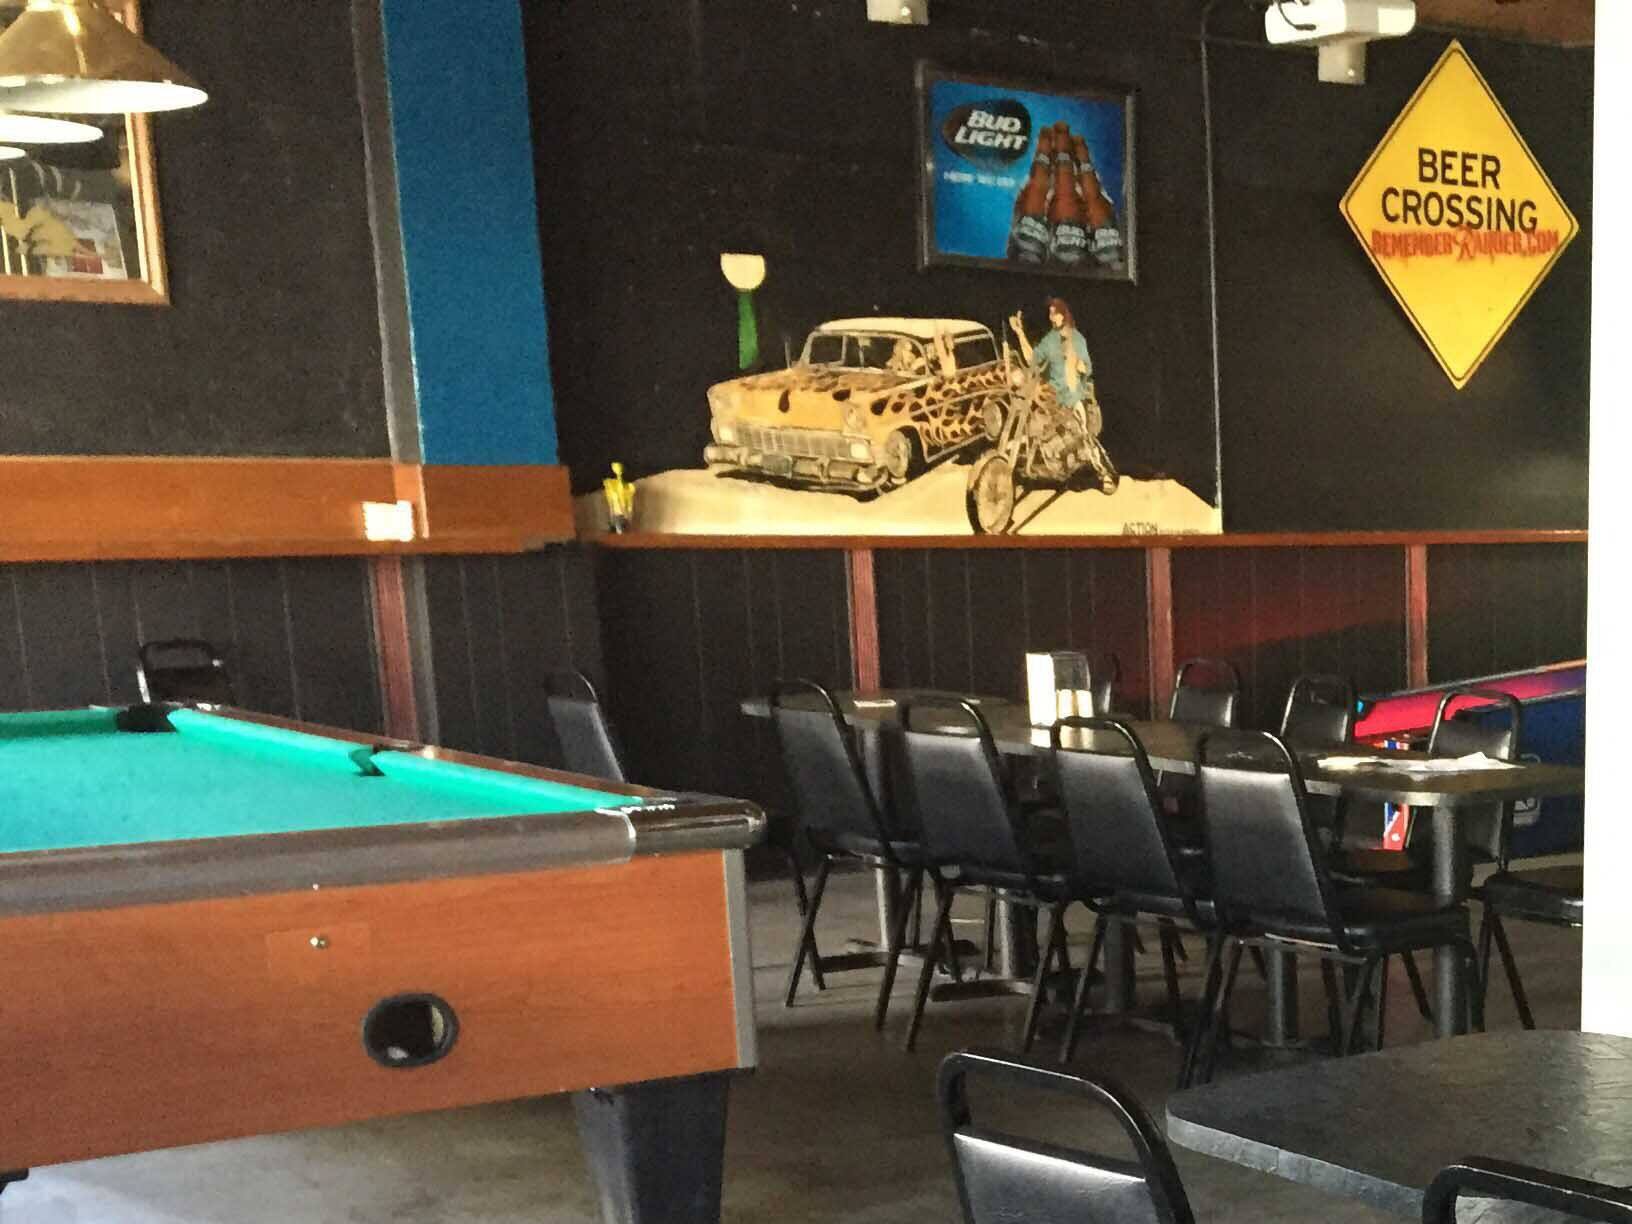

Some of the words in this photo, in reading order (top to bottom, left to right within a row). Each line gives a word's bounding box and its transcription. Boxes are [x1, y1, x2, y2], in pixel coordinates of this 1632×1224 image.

[966, 109, 1022, 133] BUD
[954, 126, 1029, 150] LIGHT
[1418, 147, 1501, 190] BEER
[1381, 186, 1538, 234] CROSSING
